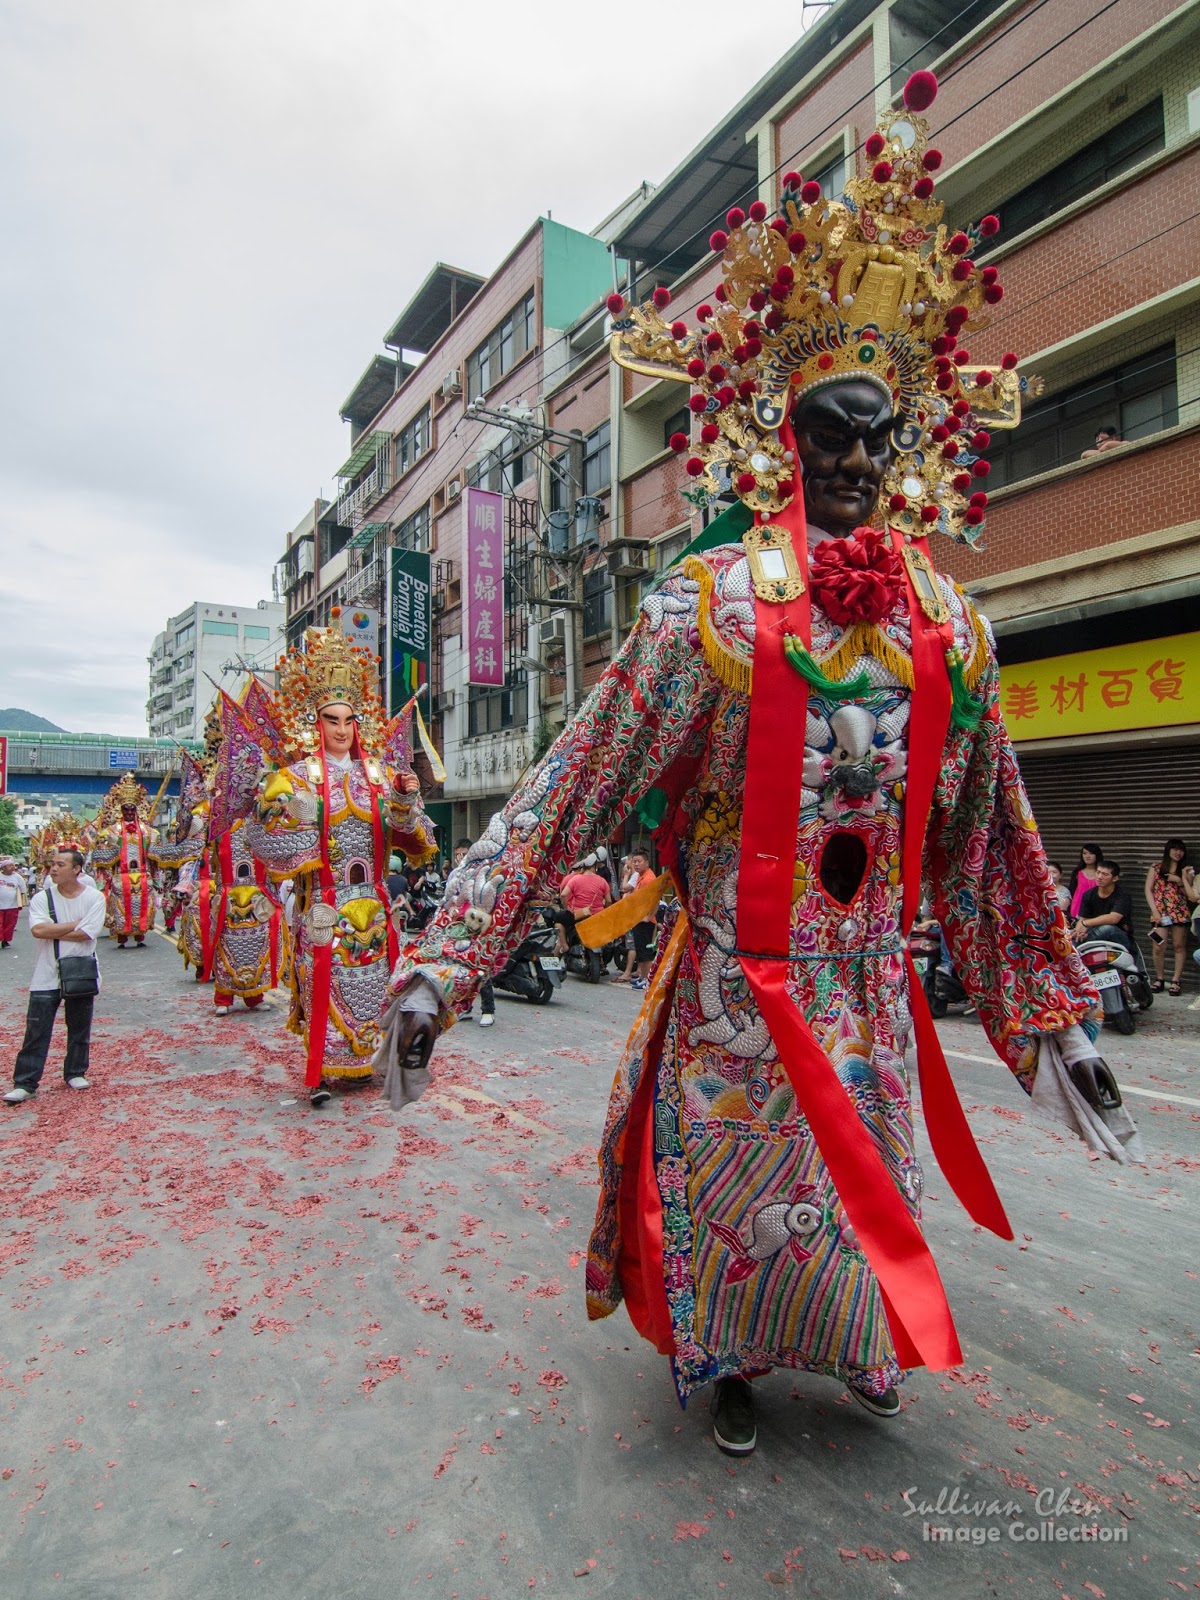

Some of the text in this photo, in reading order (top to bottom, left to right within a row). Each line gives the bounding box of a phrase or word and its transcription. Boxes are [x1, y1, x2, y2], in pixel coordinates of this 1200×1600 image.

[398, 569, 415, 648] Formula 1
[414, 578, 429, 651] Benetton
[474, 503, 497, 676] 順生婦產科
[1006, 658, 1186, 721] 美材百貨
